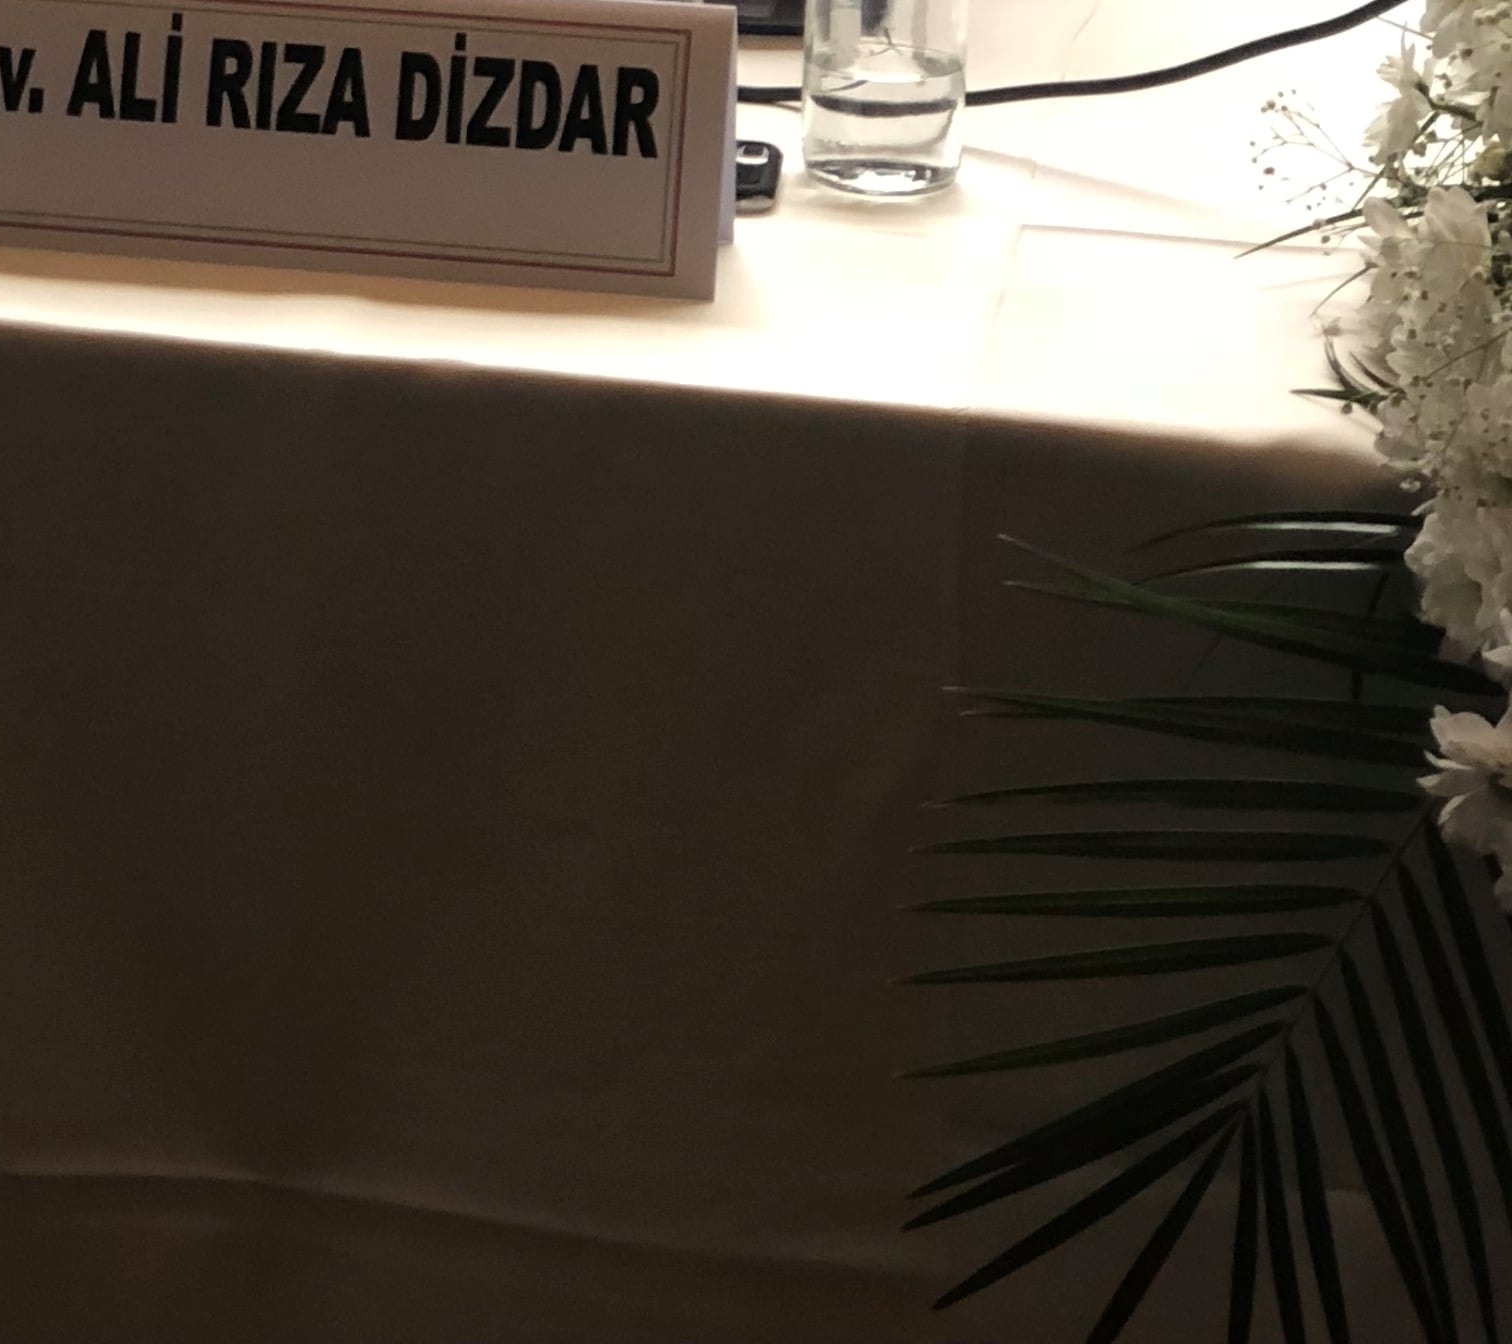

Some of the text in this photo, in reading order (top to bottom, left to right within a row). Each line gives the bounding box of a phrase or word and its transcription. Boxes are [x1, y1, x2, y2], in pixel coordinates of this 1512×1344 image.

[66, 13, 184, 124] ALİ
[206, 37, 371, 138] RIZA
[397, 32, 660, 159] DİZDAR
